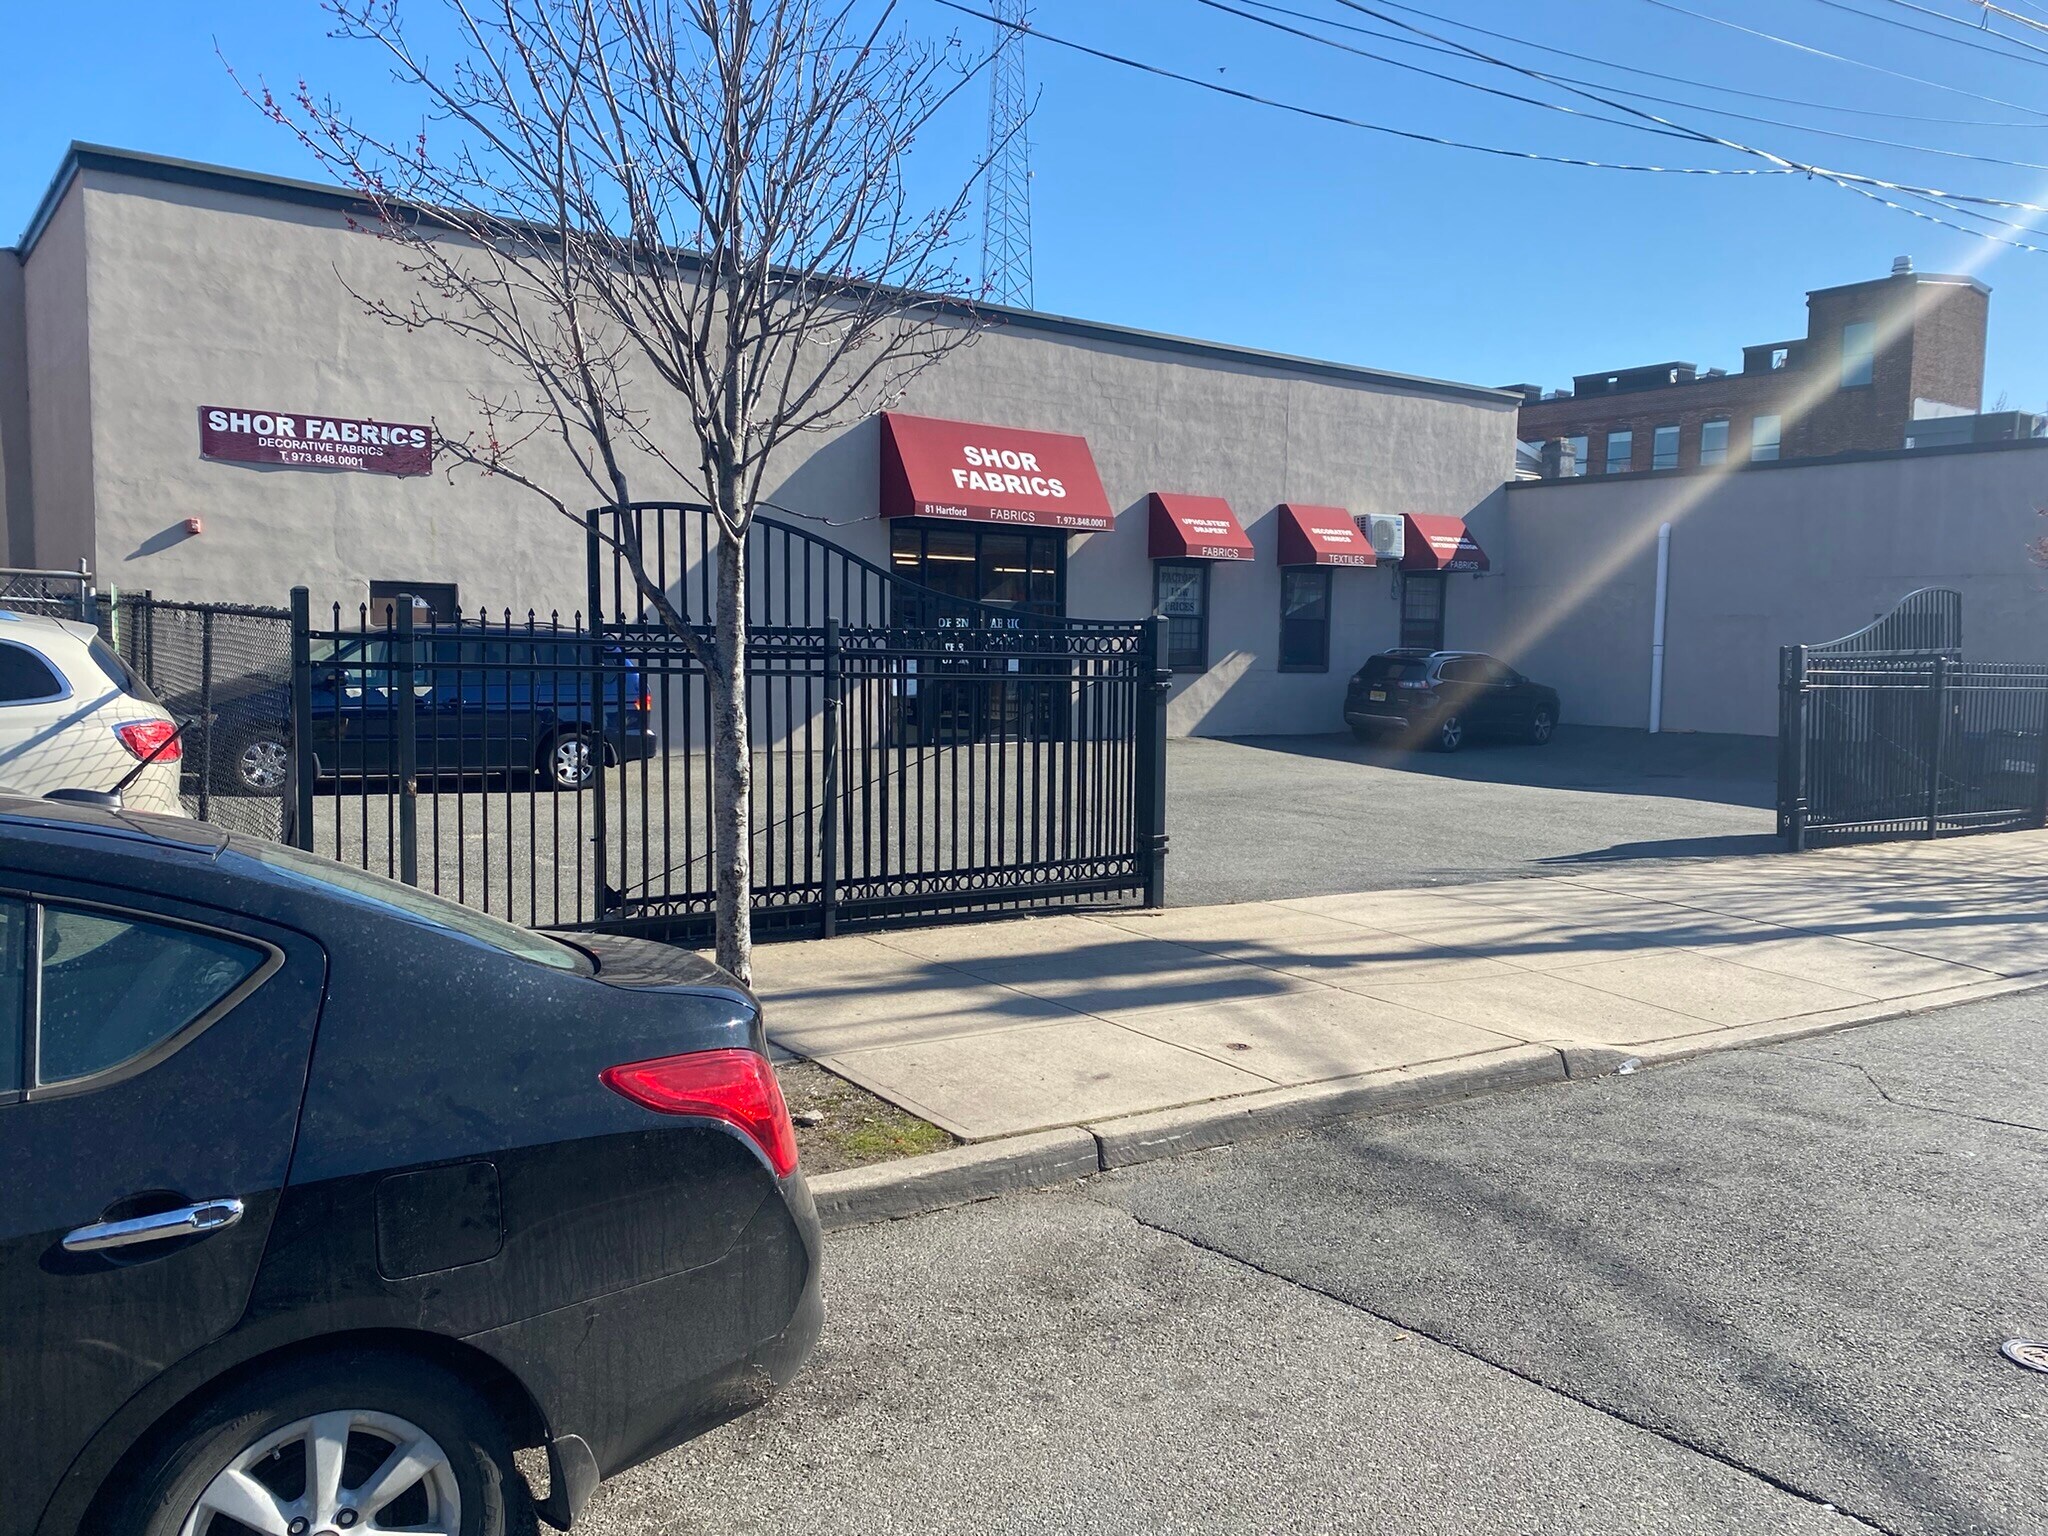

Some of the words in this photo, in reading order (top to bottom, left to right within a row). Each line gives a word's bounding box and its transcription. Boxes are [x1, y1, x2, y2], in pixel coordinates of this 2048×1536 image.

[208, 410, 297, 438] SHOR
[305, 419, 427, 449] FABRICS
[258, 437, 333, 453] DECORATIVE
[335, 443, 384, 457] FABRICS
[291, 452, 364, 467] 973.848.0001
[963, 445, 1041, 473] SHOR
[951, 468, 1067, 498] FABRICS
[924, 504, 934, 515] 81
[935, 505, 968, 518] Hartford
[990, 508, 1036, 523] FABRICS
[1181, 518, 1230, 528] UPHOLSTERY
[1193, 527, 1228, 535] DRAPERY
[1311, 528, 1354, 536] DECORATIVE
[1322, 535, 1352, 543] FABRICS
[1202, 546, 1239, 558] FABRICS
[1328, 554, 1365, 565] TEXTILES
[1450, 560, 1479, 570] FABRICS
[1164, 601, 1195, 612] PRICES
